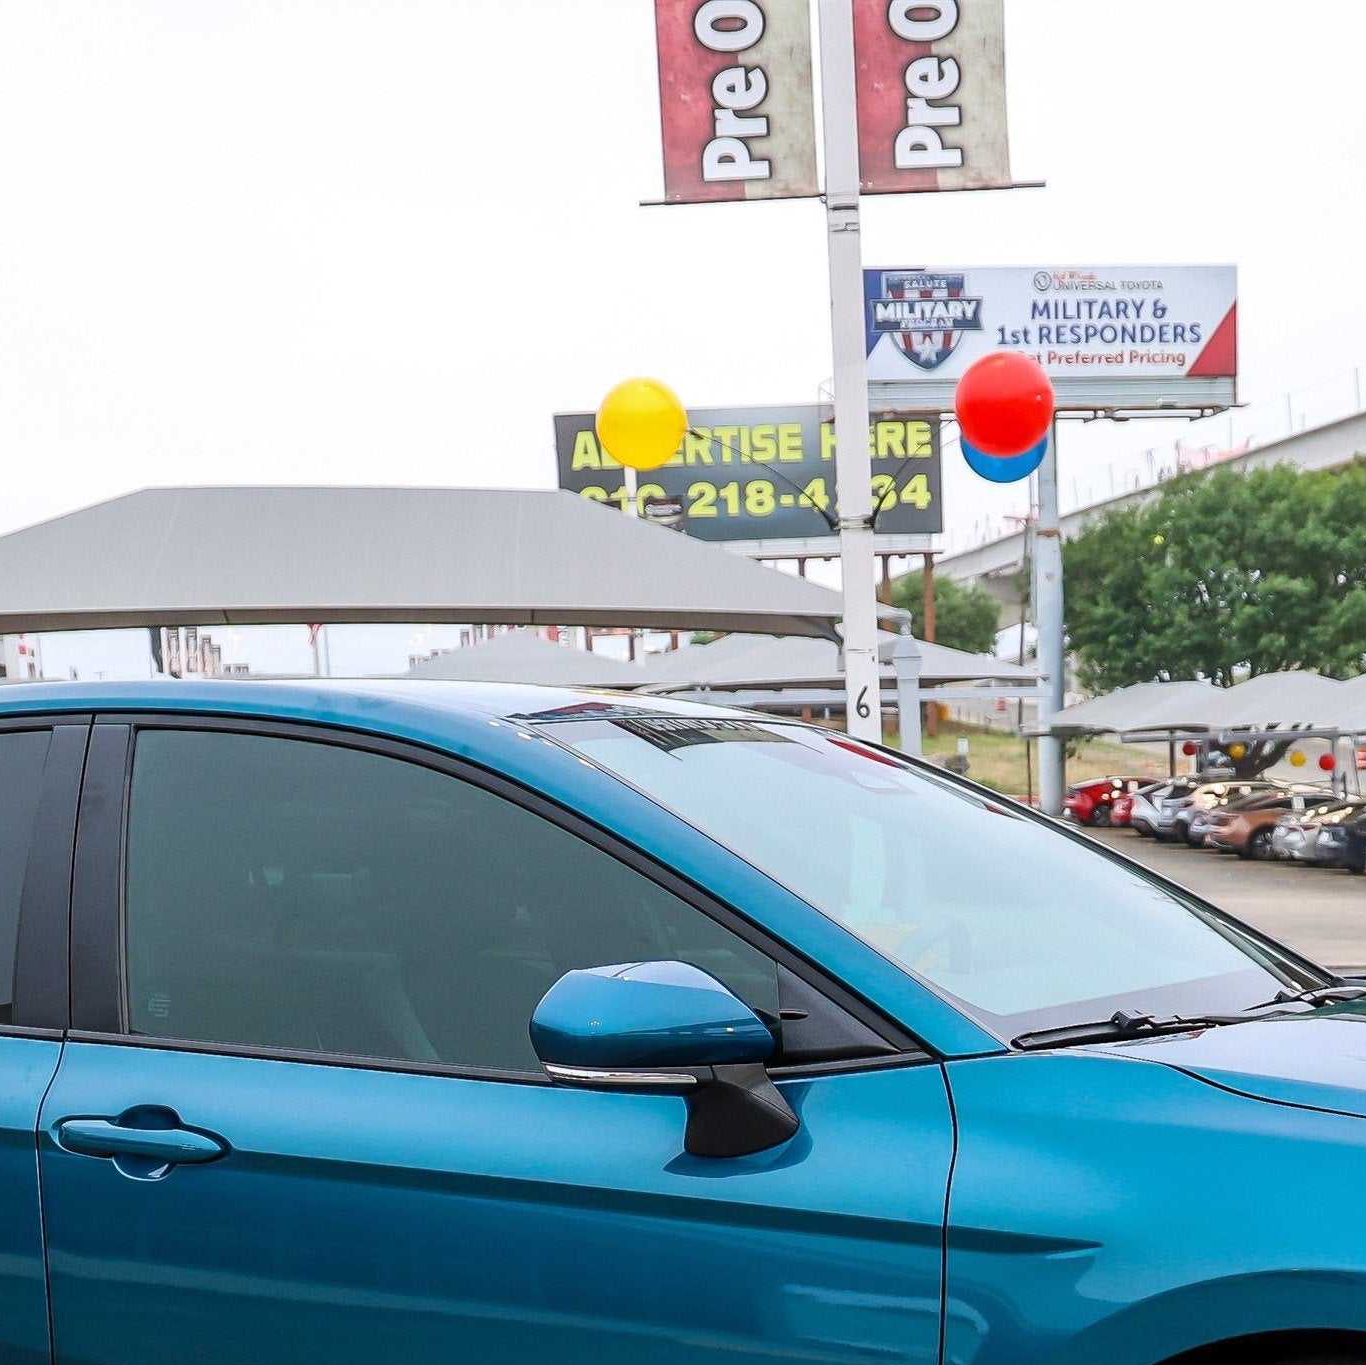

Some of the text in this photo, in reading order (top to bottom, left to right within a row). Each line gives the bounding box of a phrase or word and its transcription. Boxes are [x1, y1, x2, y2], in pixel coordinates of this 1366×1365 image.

[894, 55, 963, 169] Pre
[702, 66, 772, 182] Pre
[904, 280, 948, 289] SALUTE
[1053, 280, 1164, 291] UNIVERSAL TOYOTA
[876, 301, 977, 321] MILITARY
[1031, 298, 1168, 320] MILITARY &
[997, 322, 1202, 345] 1st RESPONDERS
[1047, 350, 1124, 364] Preferred
[1129, 350, 1186, 367] Pricing
[856, 685, 871, 718] 6
